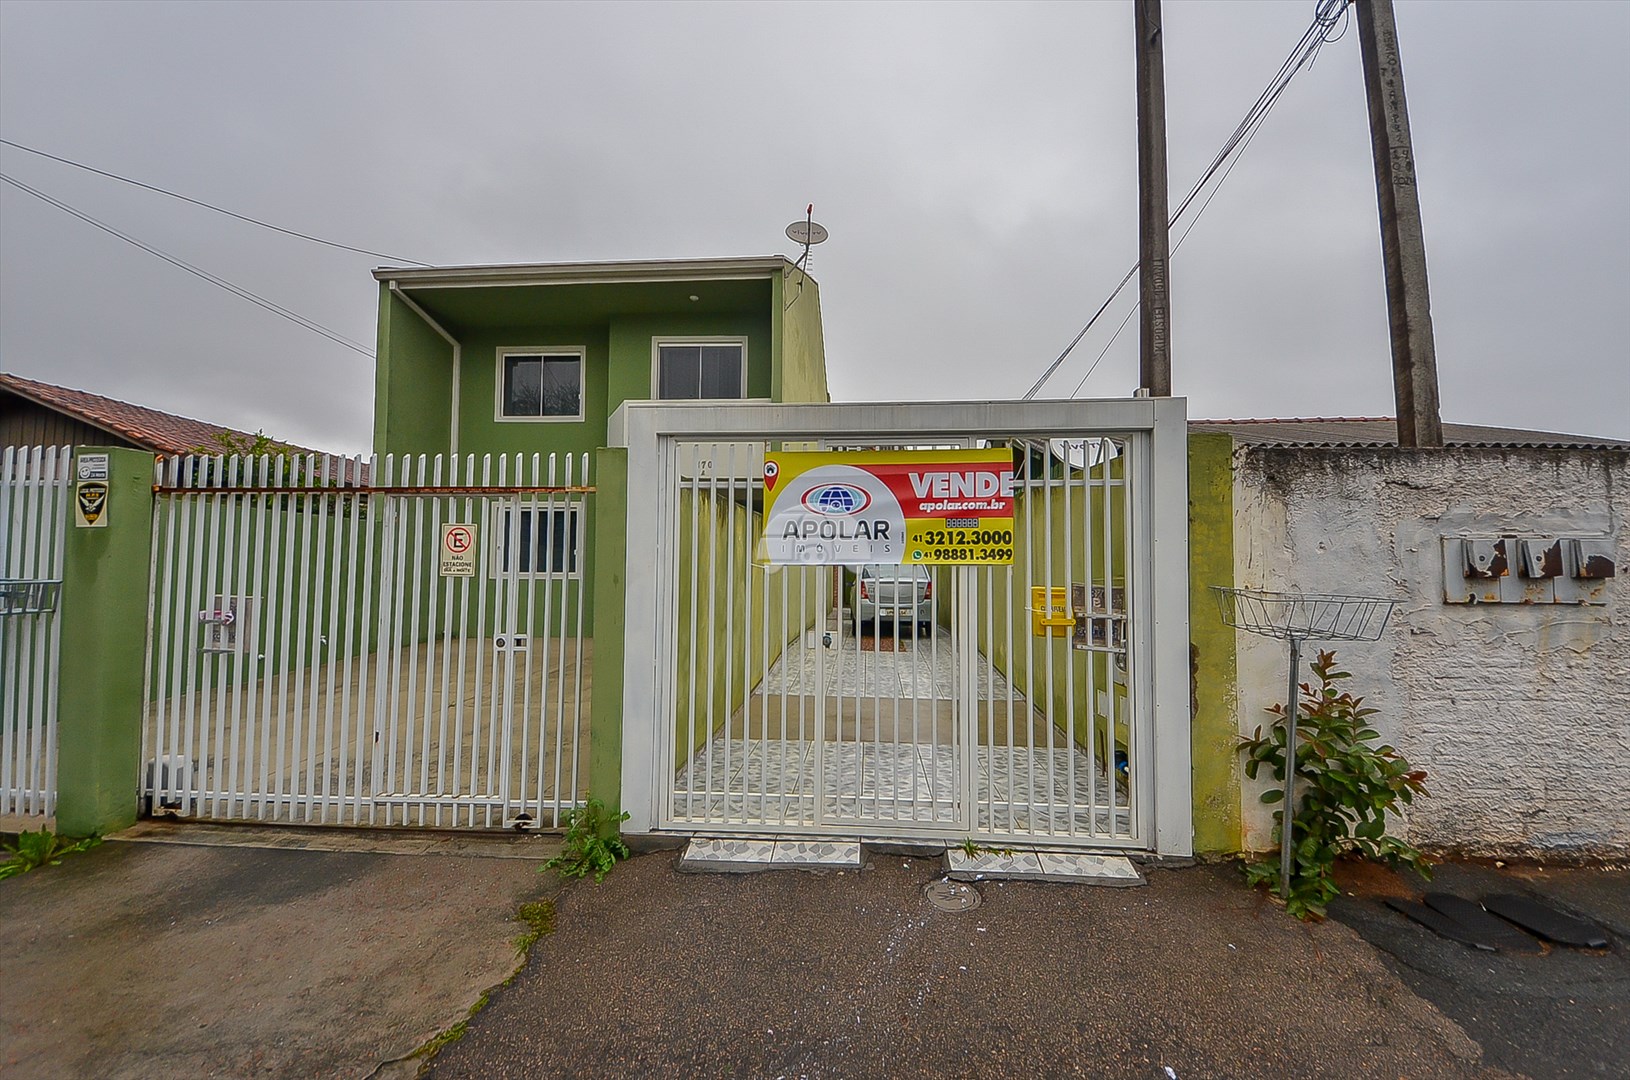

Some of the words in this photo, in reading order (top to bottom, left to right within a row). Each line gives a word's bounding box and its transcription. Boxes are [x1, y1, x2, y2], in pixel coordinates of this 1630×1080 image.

[908, 471, 1014, 498] VENDE
[919, 499, 1006, 513] apolar.com.br
[783, 520, 890, 540] APOLAR
[912, 534, 923, 543] 41
[924, 530, 1013, 546] 3212.3000
[933, 548, 1013, 561] 98881.3499
